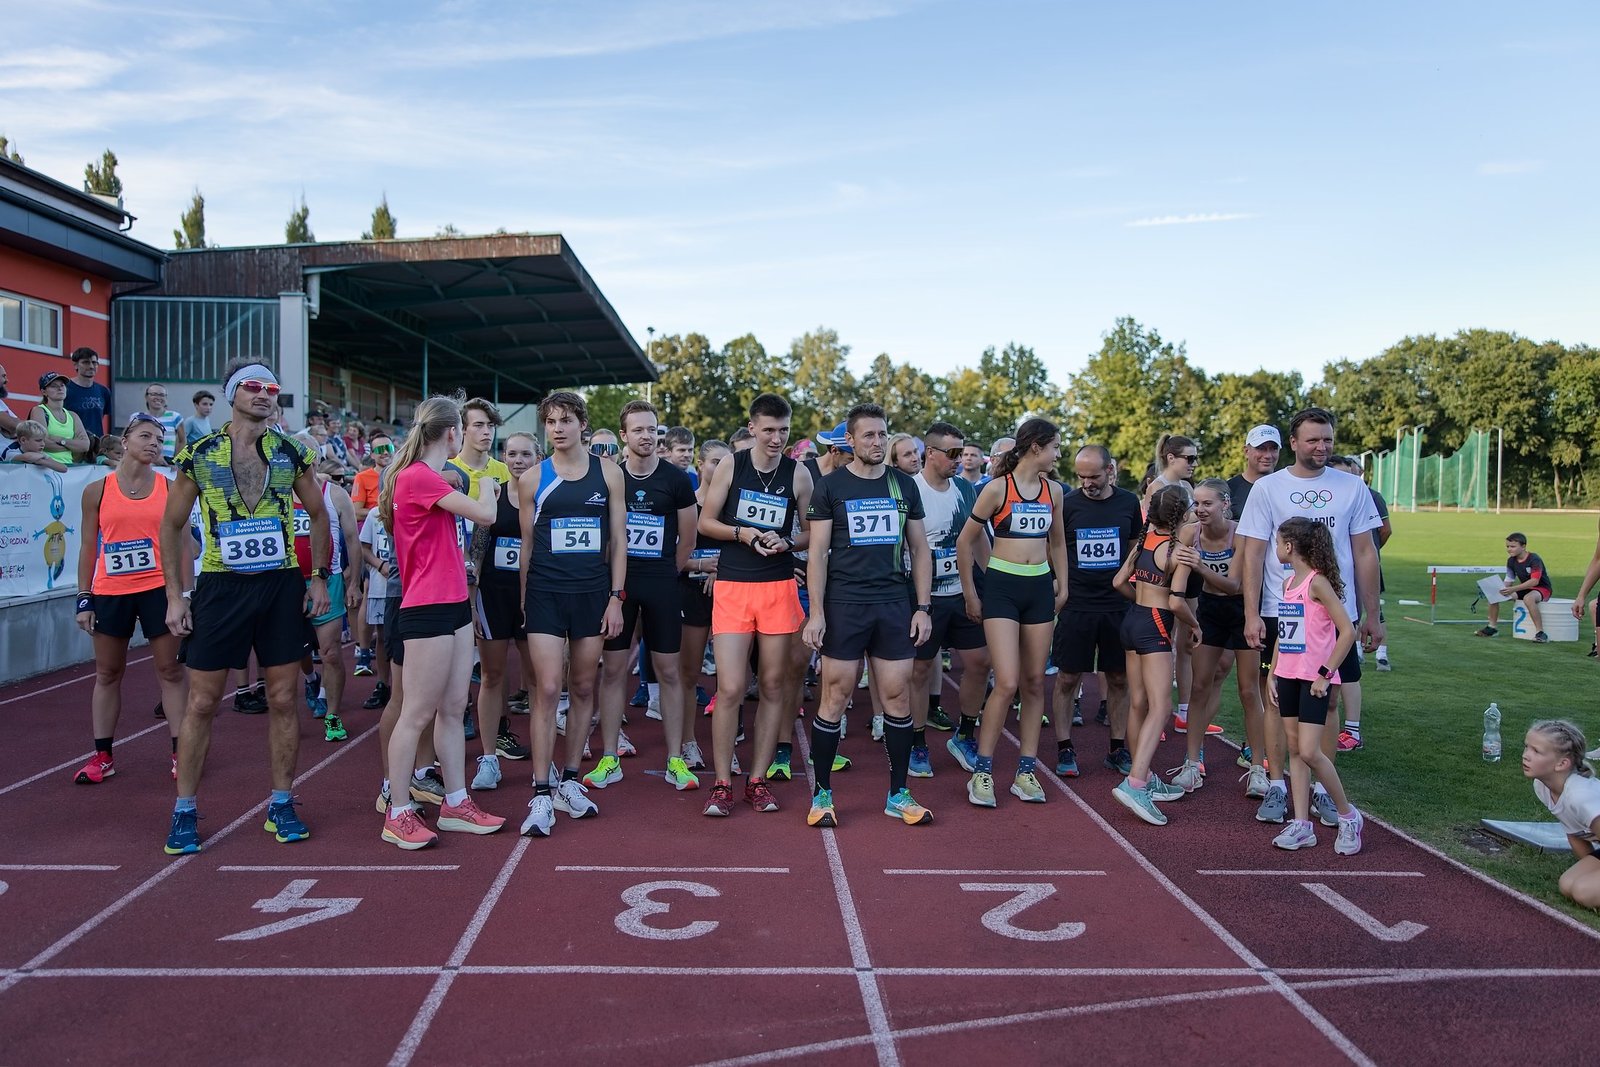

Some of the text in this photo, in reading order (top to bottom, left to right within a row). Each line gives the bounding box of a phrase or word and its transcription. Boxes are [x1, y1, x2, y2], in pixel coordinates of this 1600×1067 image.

[747, 506, 776, 522] 911
[238, 520, 260, 528] Večerní
[853, 515, 891, 533] 371
[1020, 517, 1045, 529] 910
[565, 531, 591, 547] 54
[226, 537, 279, 560] 388
[1081, 542, 1116, 558] 484
[111, 551, 151, 570] 313
[506, 550, 518, 565] 9
[944, 560, 958, 572] 91
[1203, 563, 1229, 577] 09
[1515, 606, 1526, 634] 2
[215, 879, 364, 941] 4
[614, 880, 720, 940] 3
[959, 882, 1086, 941] 2
[1300, 882, 1430, 941] 1
